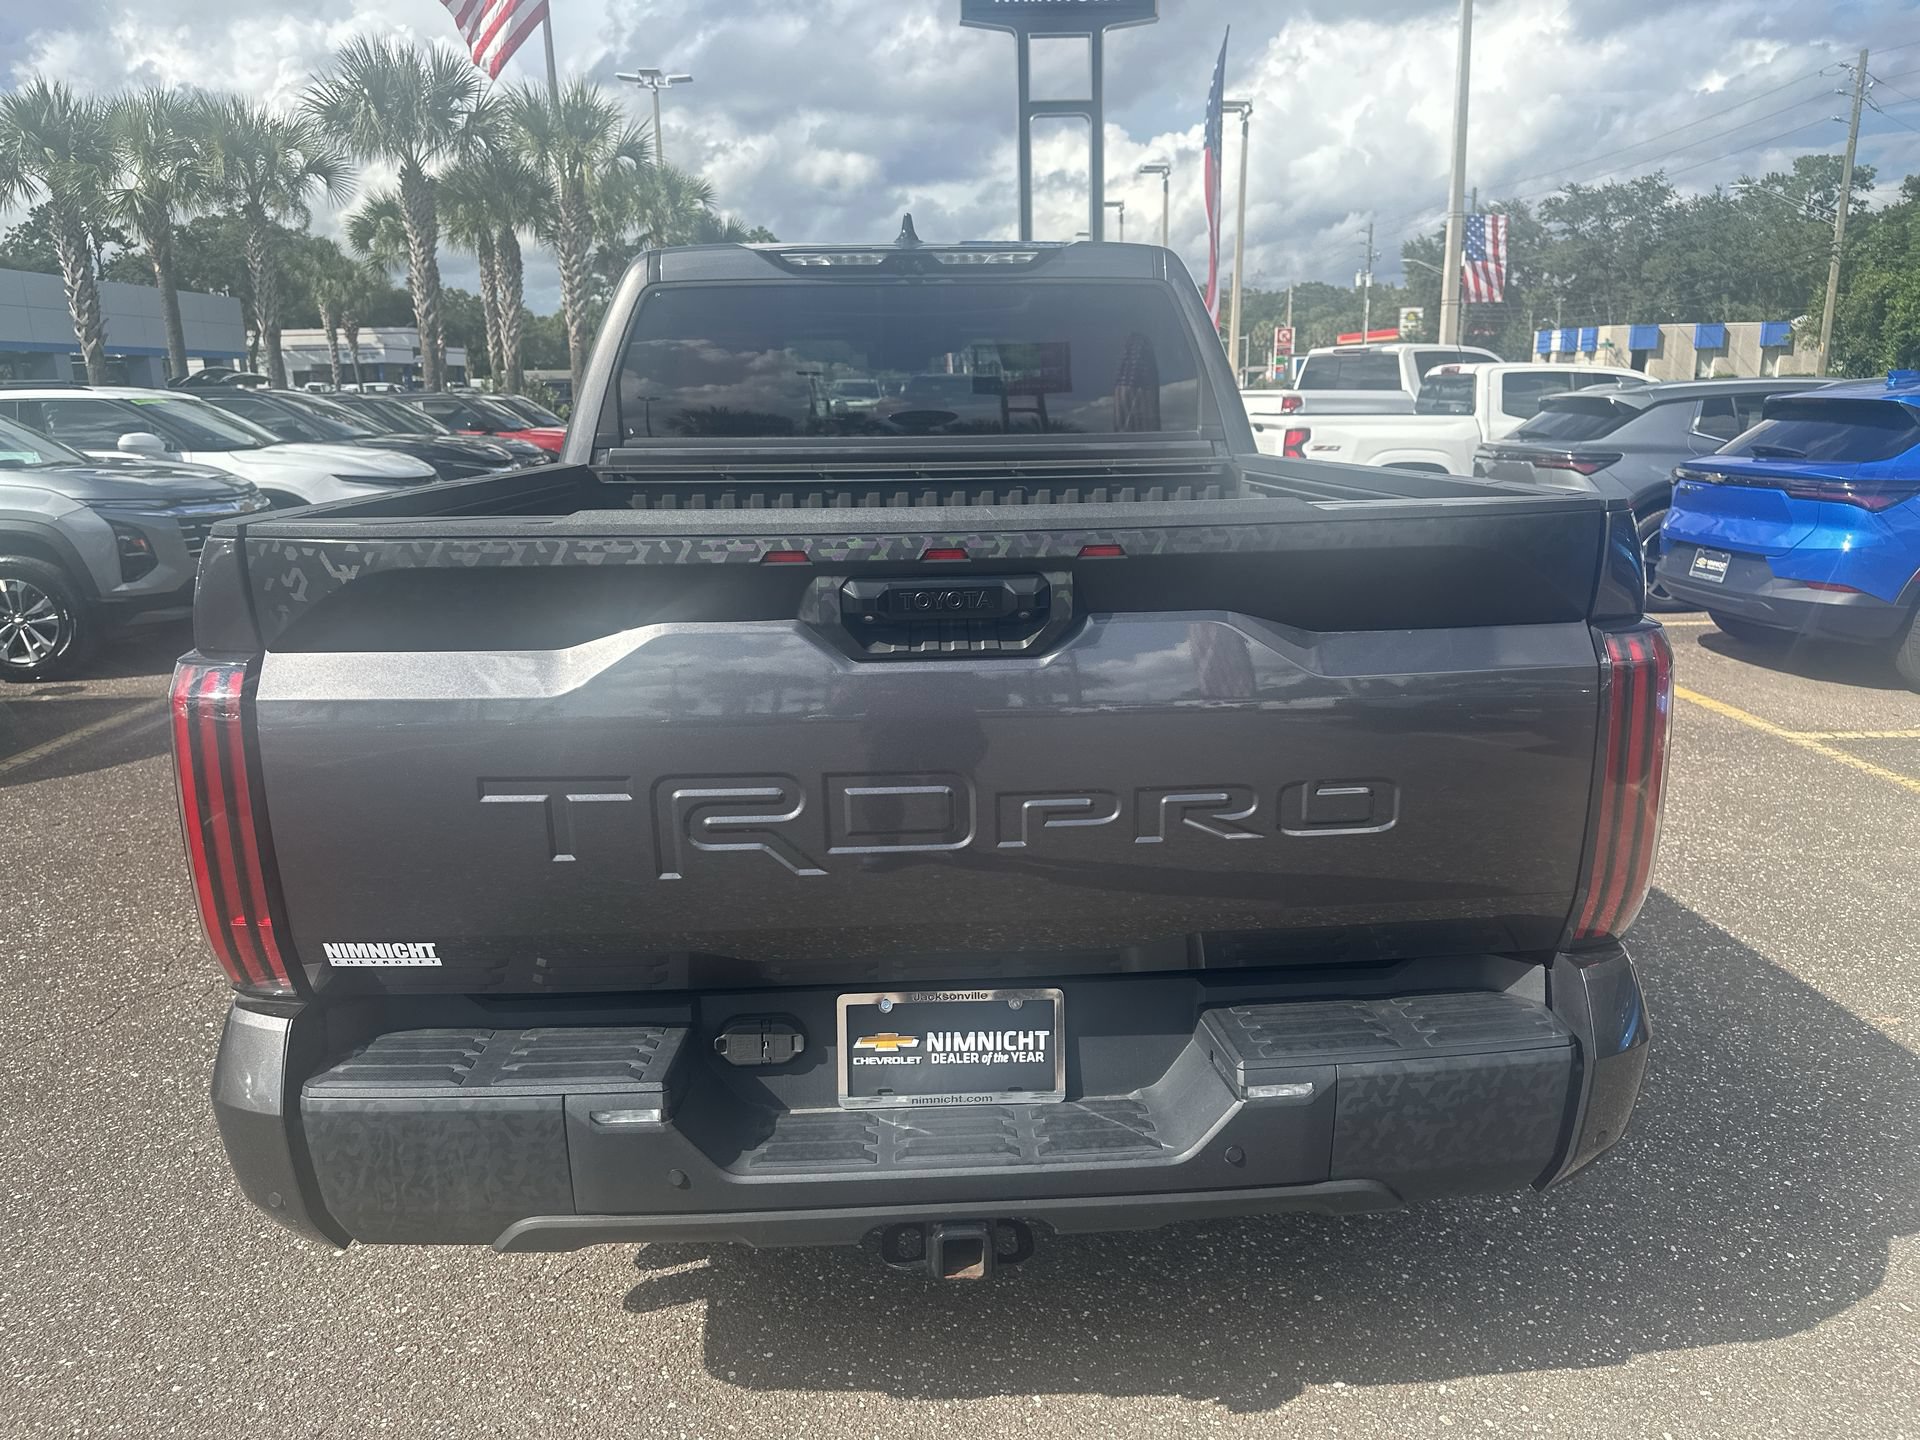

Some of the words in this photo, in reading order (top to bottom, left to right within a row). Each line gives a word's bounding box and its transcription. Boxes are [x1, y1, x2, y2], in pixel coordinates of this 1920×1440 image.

[900, 591, 993, 610] TOYOTA
[476, 771, 978, 880] TRD
[995, 776, 1400, 848] PRO
[323, 942, 436, 958] NIMNICHT
[913, 991, 988, 1001] Jacksonville
[926, 1031, 1049, 1052] NIMNICHT
[853, 1056, 922, 1065] CHEVROLET
[931, 1053, 979, 1064] DEALER
[981, 1053, 993, 1066] of
[993, 1052, 1009, 1063] the
[1010, 1052, 1044, 1063] YEAR
[911, 1095, 993, 1105] nimnicht.com
